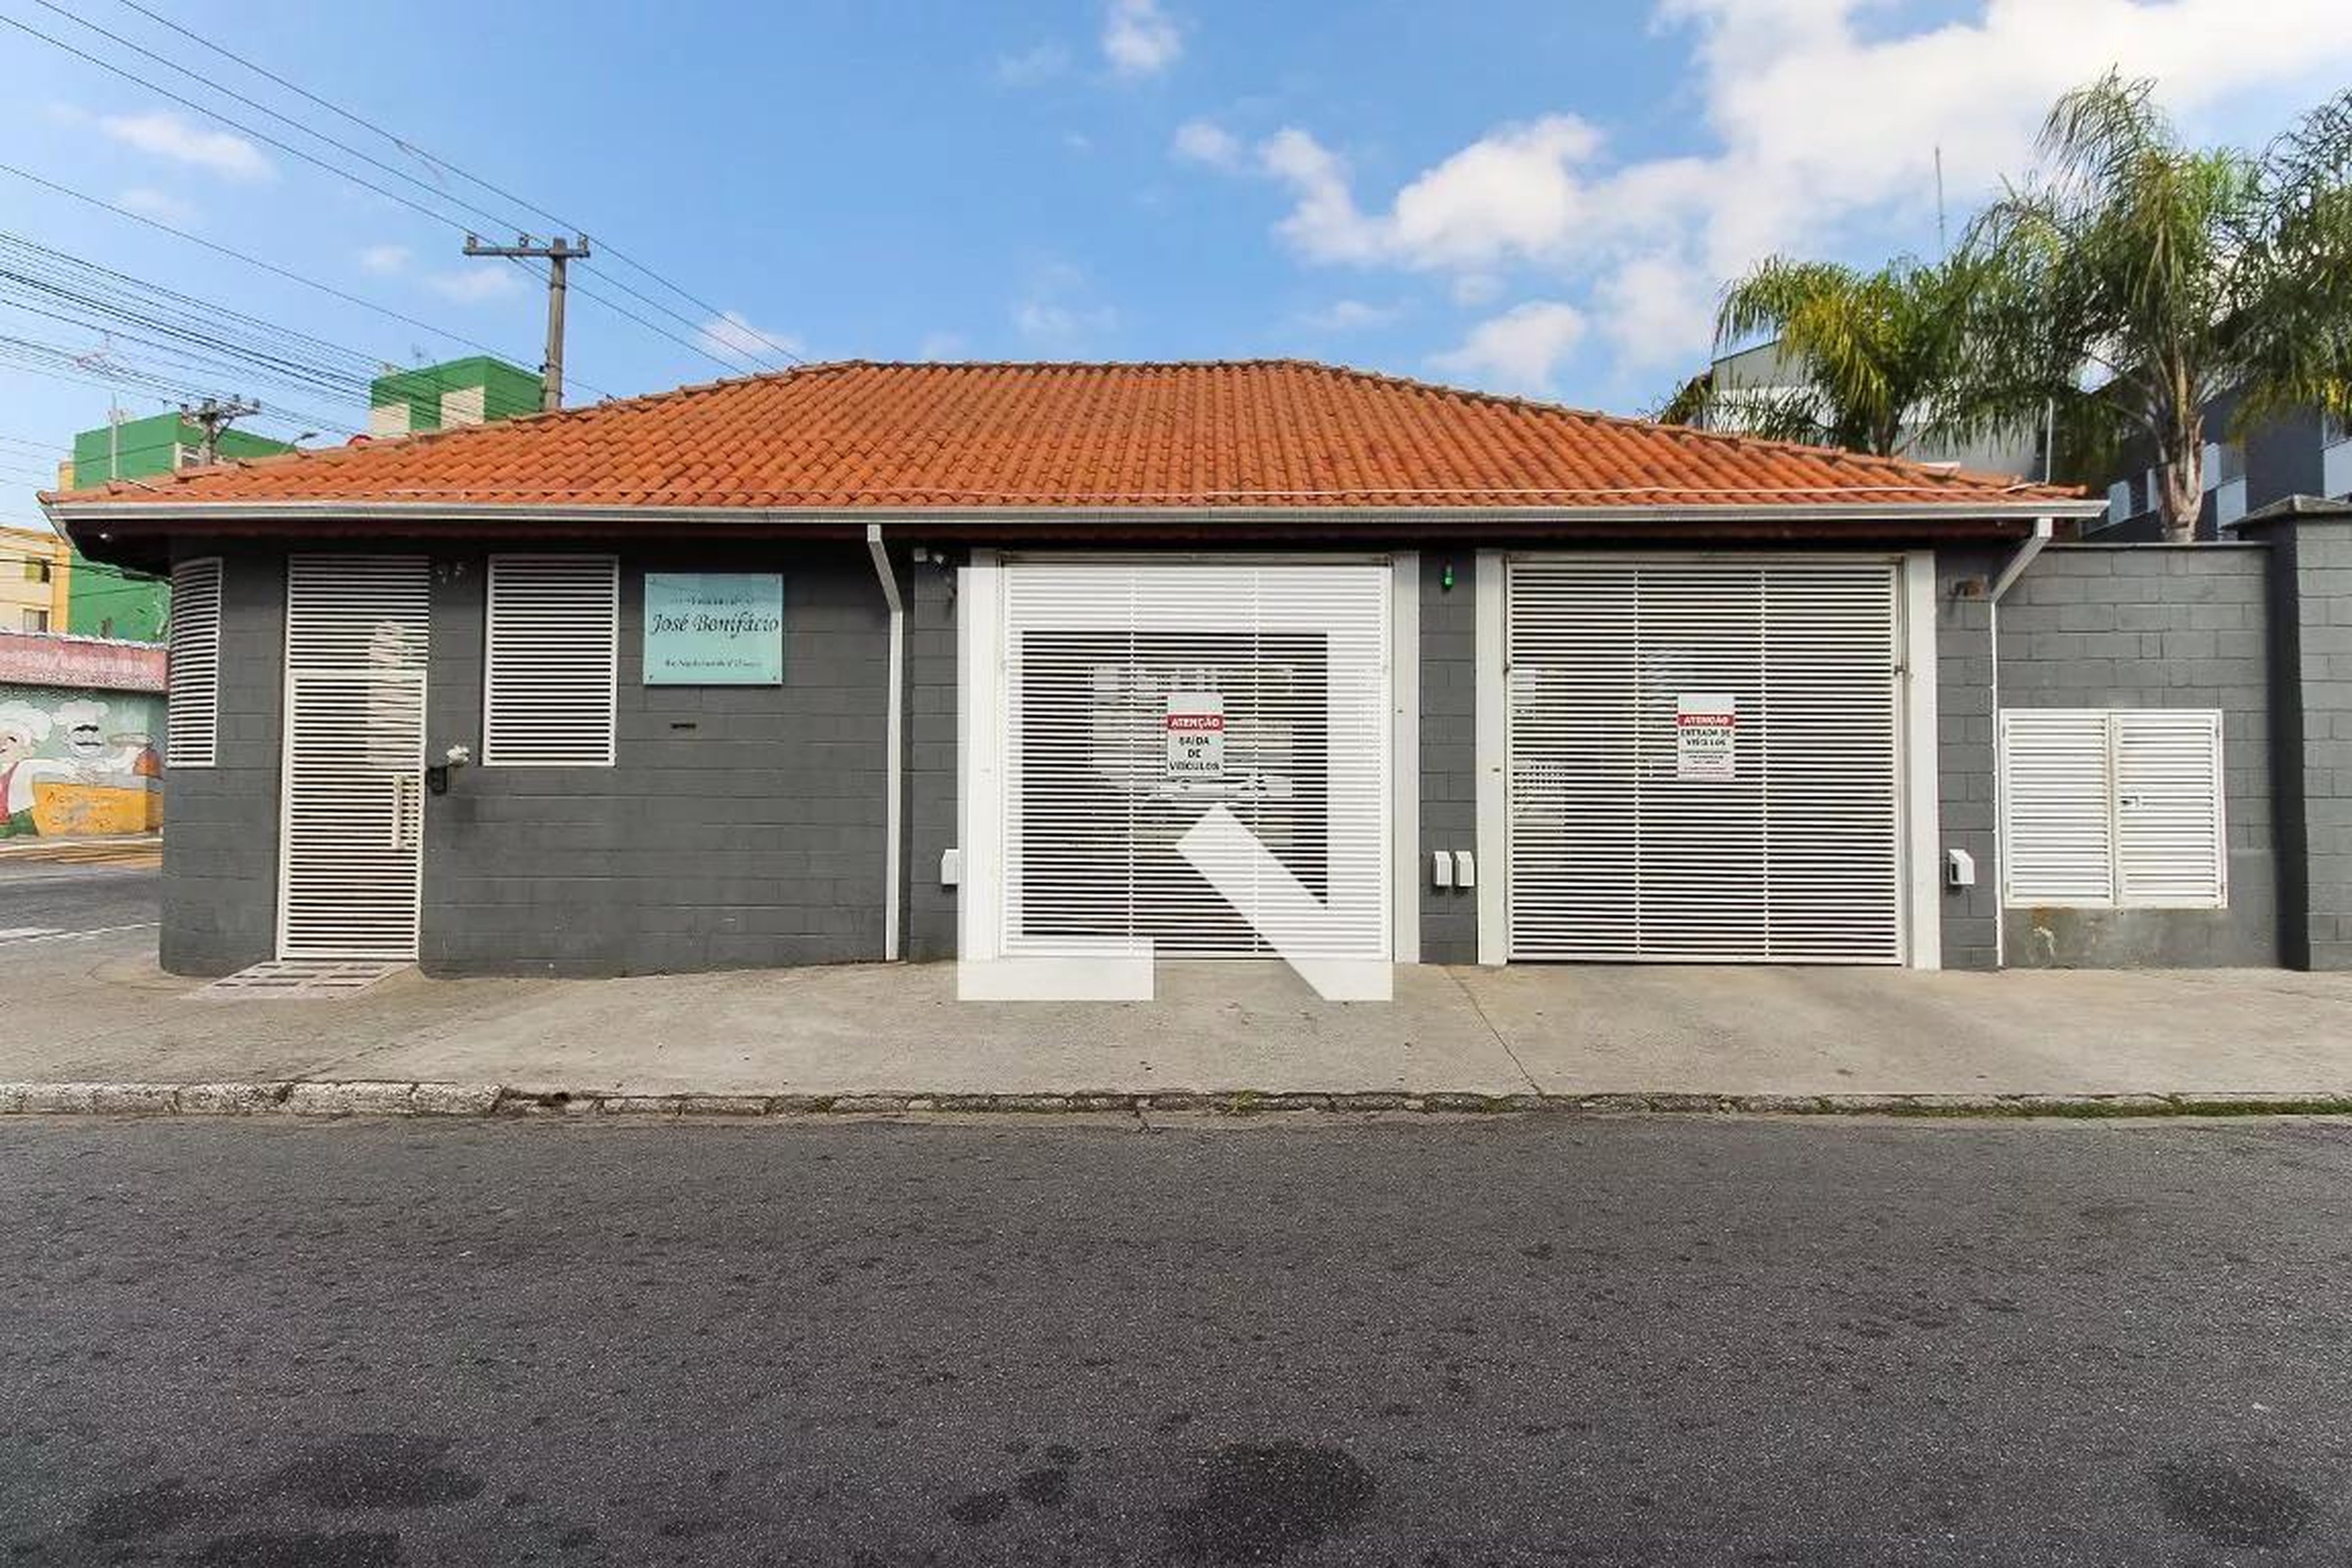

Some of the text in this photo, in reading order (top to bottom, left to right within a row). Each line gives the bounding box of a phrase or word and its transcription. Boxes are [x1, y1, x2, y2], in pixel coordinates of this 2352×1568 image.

[651, 611, 779, 638] José Bonifácio
[1170, 717, 1220, 728] ATENÇÃO
[1188, 748, 1202, 758] DE
